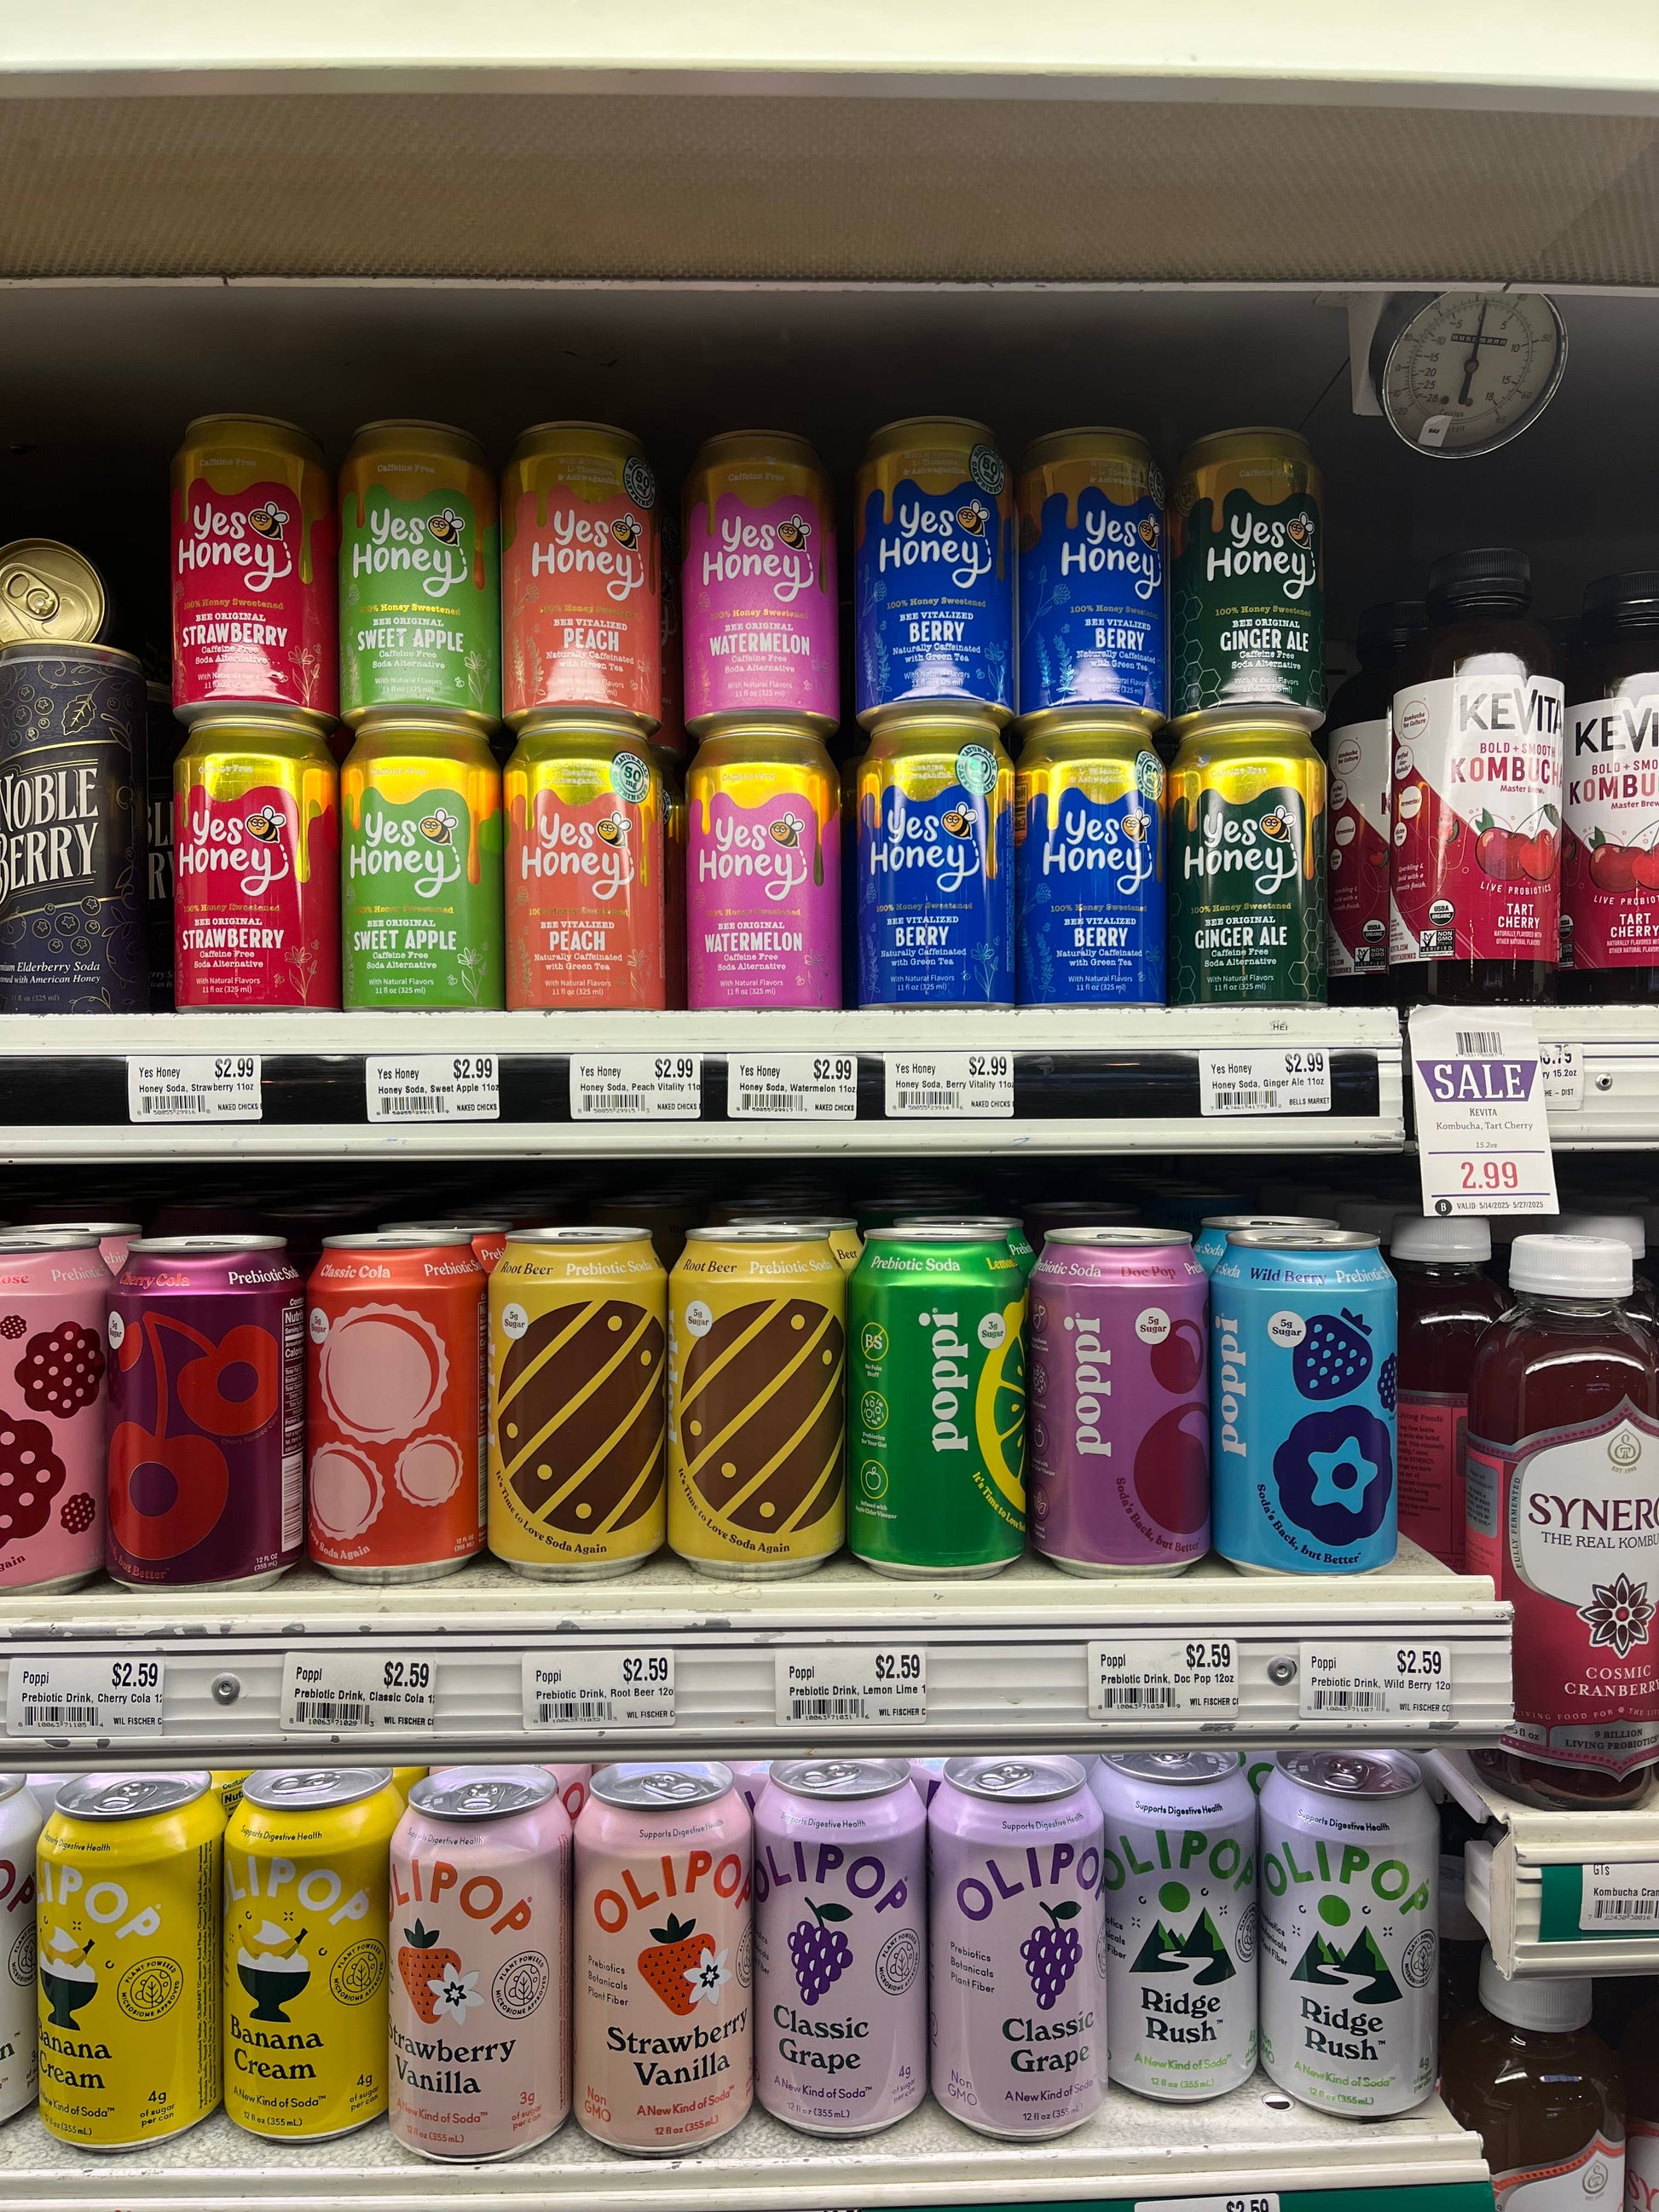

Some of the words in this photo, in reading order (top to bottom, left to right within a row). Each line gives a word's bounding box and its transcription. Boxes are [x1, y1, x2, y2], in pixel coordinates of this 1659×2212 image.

[178, 539, 292, 592] Honey
[353, 543, 467, 598] Honey
[879, 537, 991, 588] Honey
[899, 612, 918, 621] BEE
[920, 611, 974, 621] VITALIZED
[182, 623, 288, 648] STRAWBERRY
[358, 628, 408, 651] SWEET
[412, 628, 464, 652] APPLE
[564, 628, 619, 651] PEACH
[909, 621, 965, 643] BERRY
[1095, 627, 1145, 651] BERRY
[1220, 628, 1282, 651] GINGER
[1286, 632, 1309, 653] ALE
[709, 633, 810, 656] WATERMELON
[1480, 742, 1510, 754] BOLD
[179, 842, 289, 896] Honey
[1184, 845, 1298, 895] Honey
[1480, 881, 1502, 893] LIVE
[1508, 884, 1551, 895] PROBIOTICS
[1507, 904, 1534, 915] TART
[1498, 916, 1540, 929] CHERRY
[182, 929, 285, 950] STRAWBERRY
[354, 930, 400, 950] SWEET
[404, 930, 457, 950] APPLE
[549, 931, 605, 951] PEACH
[704, 933, 802, 952] WATERMELON
[895, 926, 949, 947] BERRY
[1074, 927, 1128, 948] BERRY
[1194, 927, 1255, 949] GINGER
[1259, 927, 1287, 946] ALE
[880, 949, 916, 958] Naturally
[917, 947, 967, 956] Caffeinated
[1205, 958, 1224, 967] Soda
[1226, 957, 1277, 967] Alternative
[17, 962, 71, 974] Elderberry
[74, 962, 100, 972] Soda
[30, 975, 70, 984] American
[73, 974, 101, 984] Honey
[210, 977, 233, 985] Natural
[234, 977, 260, 985] Flavors
[139, 1068, 153, 1077] Yes
[156, 1067, 180, 1078] Honey
[215, 1058, 253, 1080] $2.99
[454, 1059, 492, 1081] $2.99
[655, 1058, 693, 1080] $2.99
[813, 1059, 852, 1082] $2.99
[969, 1056, 1007, 1077] $2.99
[1285, 1053, 1324, 1075] $2.99
[139, 1085, 163, 1094] Honey
[192, 1083, 233, 1092] Strawberry
[379, 1086, 402, 1094] Honey
[456, 1084, 478, 1093] Apple
[739, 1083, 764, 1093] Honey
[766, 1084, 788, 1093] Soda,
[790, 1084, 833, 1093] Watermelon
[1212, 1081, 1235, 1089] Honey
[1433, 1065, 1526, 1099] SALE
[1436, 1122, 1483, 1130] Kombucha,
[1505, 1122, 1533, 1131] Cherry
[1460, 1162, 1518, 1189] 2.99
[321, 1264, 356, 1279] Classic
[359, 1265, 391, 1279] Cola
[500, 1262, 526, 1274] Root
[529, 1264, 553, 1274] Beer
[566, 1263, 624, 1275] Prebiotic
[627, 1262, 652, 1273] Soda
[871, 1256, 923, 1270] Prebiotic
[926, 1257, 960, 1272] Soda
[1121, 1266, 1149, 1278] Doc
[1152, 1266, 1176, 1279] Pop
[156, 1273, 190, 1287] Cola
[228, 1269, 284, 1285] Prebiotic
[1250, 1268, 1281, 1282] Wild
[1284, 1271, 1327, 1285] Berry
[1140, 1324, 1167, 1335] Sugar
[1147, 1316, 1159, 1325] 5g
[919, 1308, 968, 1452] poppi
[1064, 1313, 1111, 1457] poppi
[1216, 1312, 1246, 1458] poppi
[1541, 1532, 1572, 1546] THE
[1576, 1536, 1615, 1549] REAL
[1186, 1643, 1230, 1670] $2.59
[1397, 1649, 1442, 1675] $2.59
[112, 1662, 158, 1689] $2.59
[384, 1660, 429, 1689] $2.59
[623, 1657, 668, 1684] $2.59
[876, 1654, 920, 1682] $2.59
[1586, 1665, 1650, 1680] COSMIC
[23, 1672, 49, 1687] Poppi
[863, 1686, 893, 1695] Lemon
[896, 1685, 918, 1694] Lime
[1564, 1678, 1659, 1697] CRANBERRY
[22, 1693, 62, 1703] Prebiotic
[66, 1694, 94, 1704] Drink,
[98, 1694, 127, 1705] Cherry
[131, 1694, 150, 1703] Cola
[1604, 1729, 1643, 1739] BILLION
[263, 1829, 297, 1842] Digestive
[298, 1831, 322, 1840] Health
[639, 1828, 673, 1840] Supports
[1593, 1887, 1638, 1896] Kombucha
[587, 1971, 628, 1990] Botanicals
[1141, 1986, 1221, 2019] Ridge
[773, 2005, 869, 2039] Classic
[1301, 1995, 1384, 2033] Ridge
[230, 2014, 323, 2050] Banana
[606, 2007, 749, 2056] Strawberry
[1003, 2011, 1094, 2042] Classic
[234, 2049, 316, 2080] Cream
[778, 2037, 860, 2074] Grape
[1010, 2045, 1090, 2076] Grape
[633, 2052, 731, 2087] Vanilla
[357, 2073, 373, 2088] 4g
[585, 2104, 611, 2122] GMO
